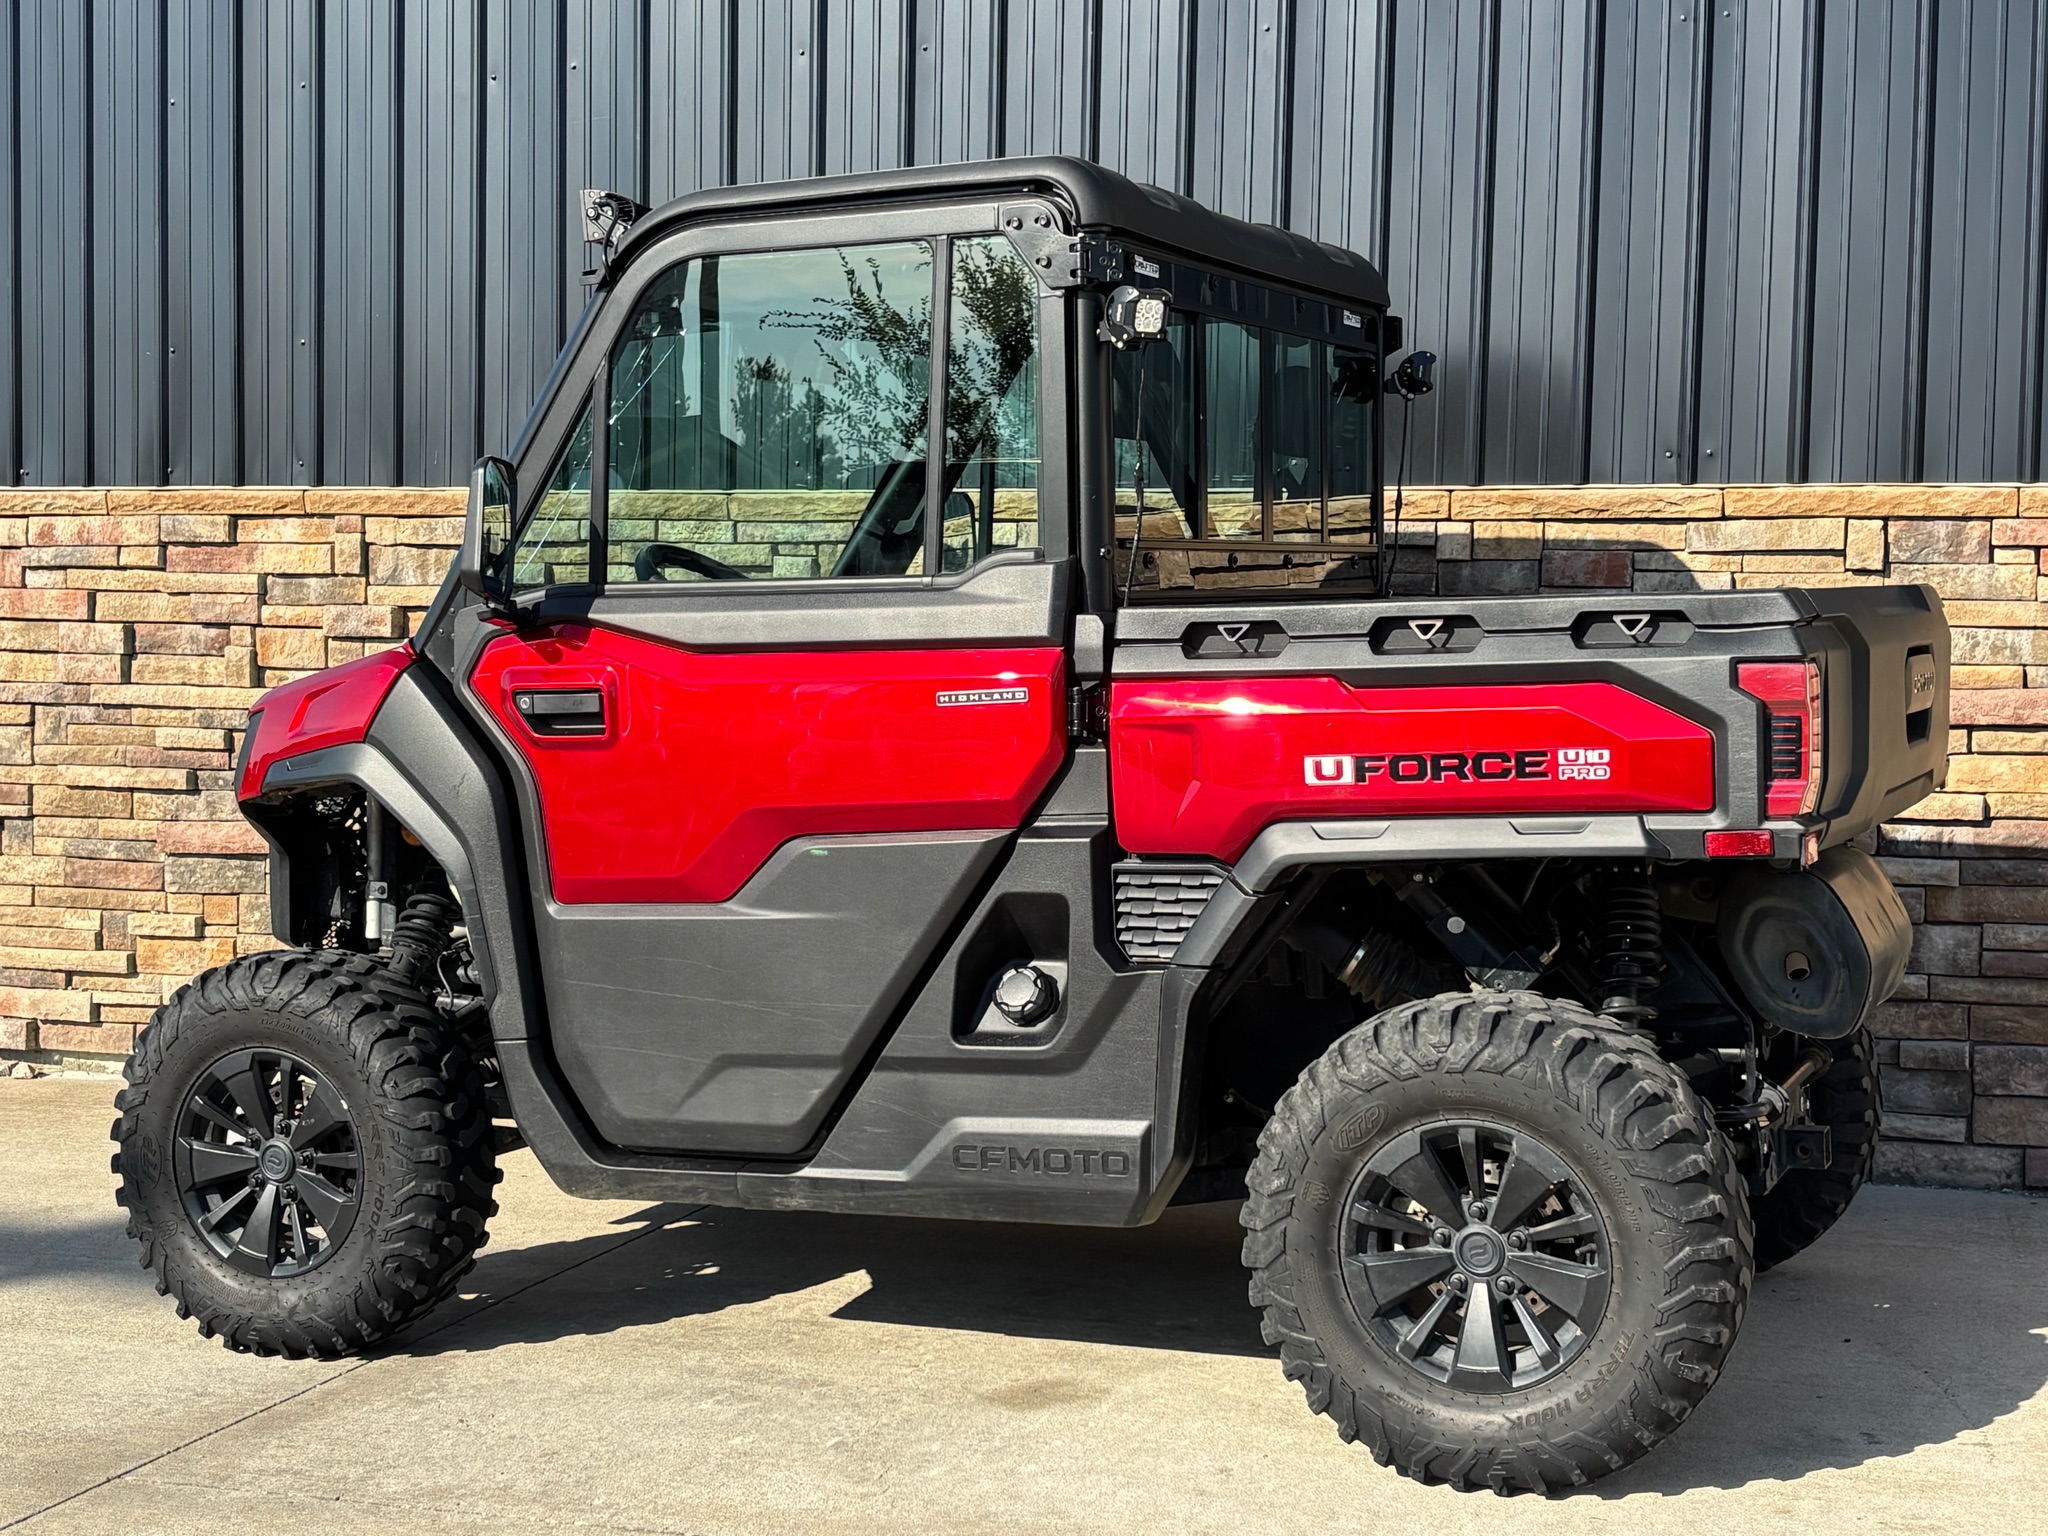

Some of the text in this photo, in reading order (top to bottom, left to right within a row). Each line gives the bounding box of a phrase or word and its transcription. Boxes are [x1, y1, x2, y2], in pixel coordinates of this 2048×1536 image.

[939, 691, 1026, 703] HIGHLAND
[1557, 749, 1610, 764] U10
[1558, 765, 1610, 780] PRO
[1338, 1104, 1382, 1149] ITP
[952, 1144, 1131, 1178] CFMOTO
[363, 1182, 386, 1241] HOOK
[1502, 1330, 1637, 1432] TERRA HOOK
